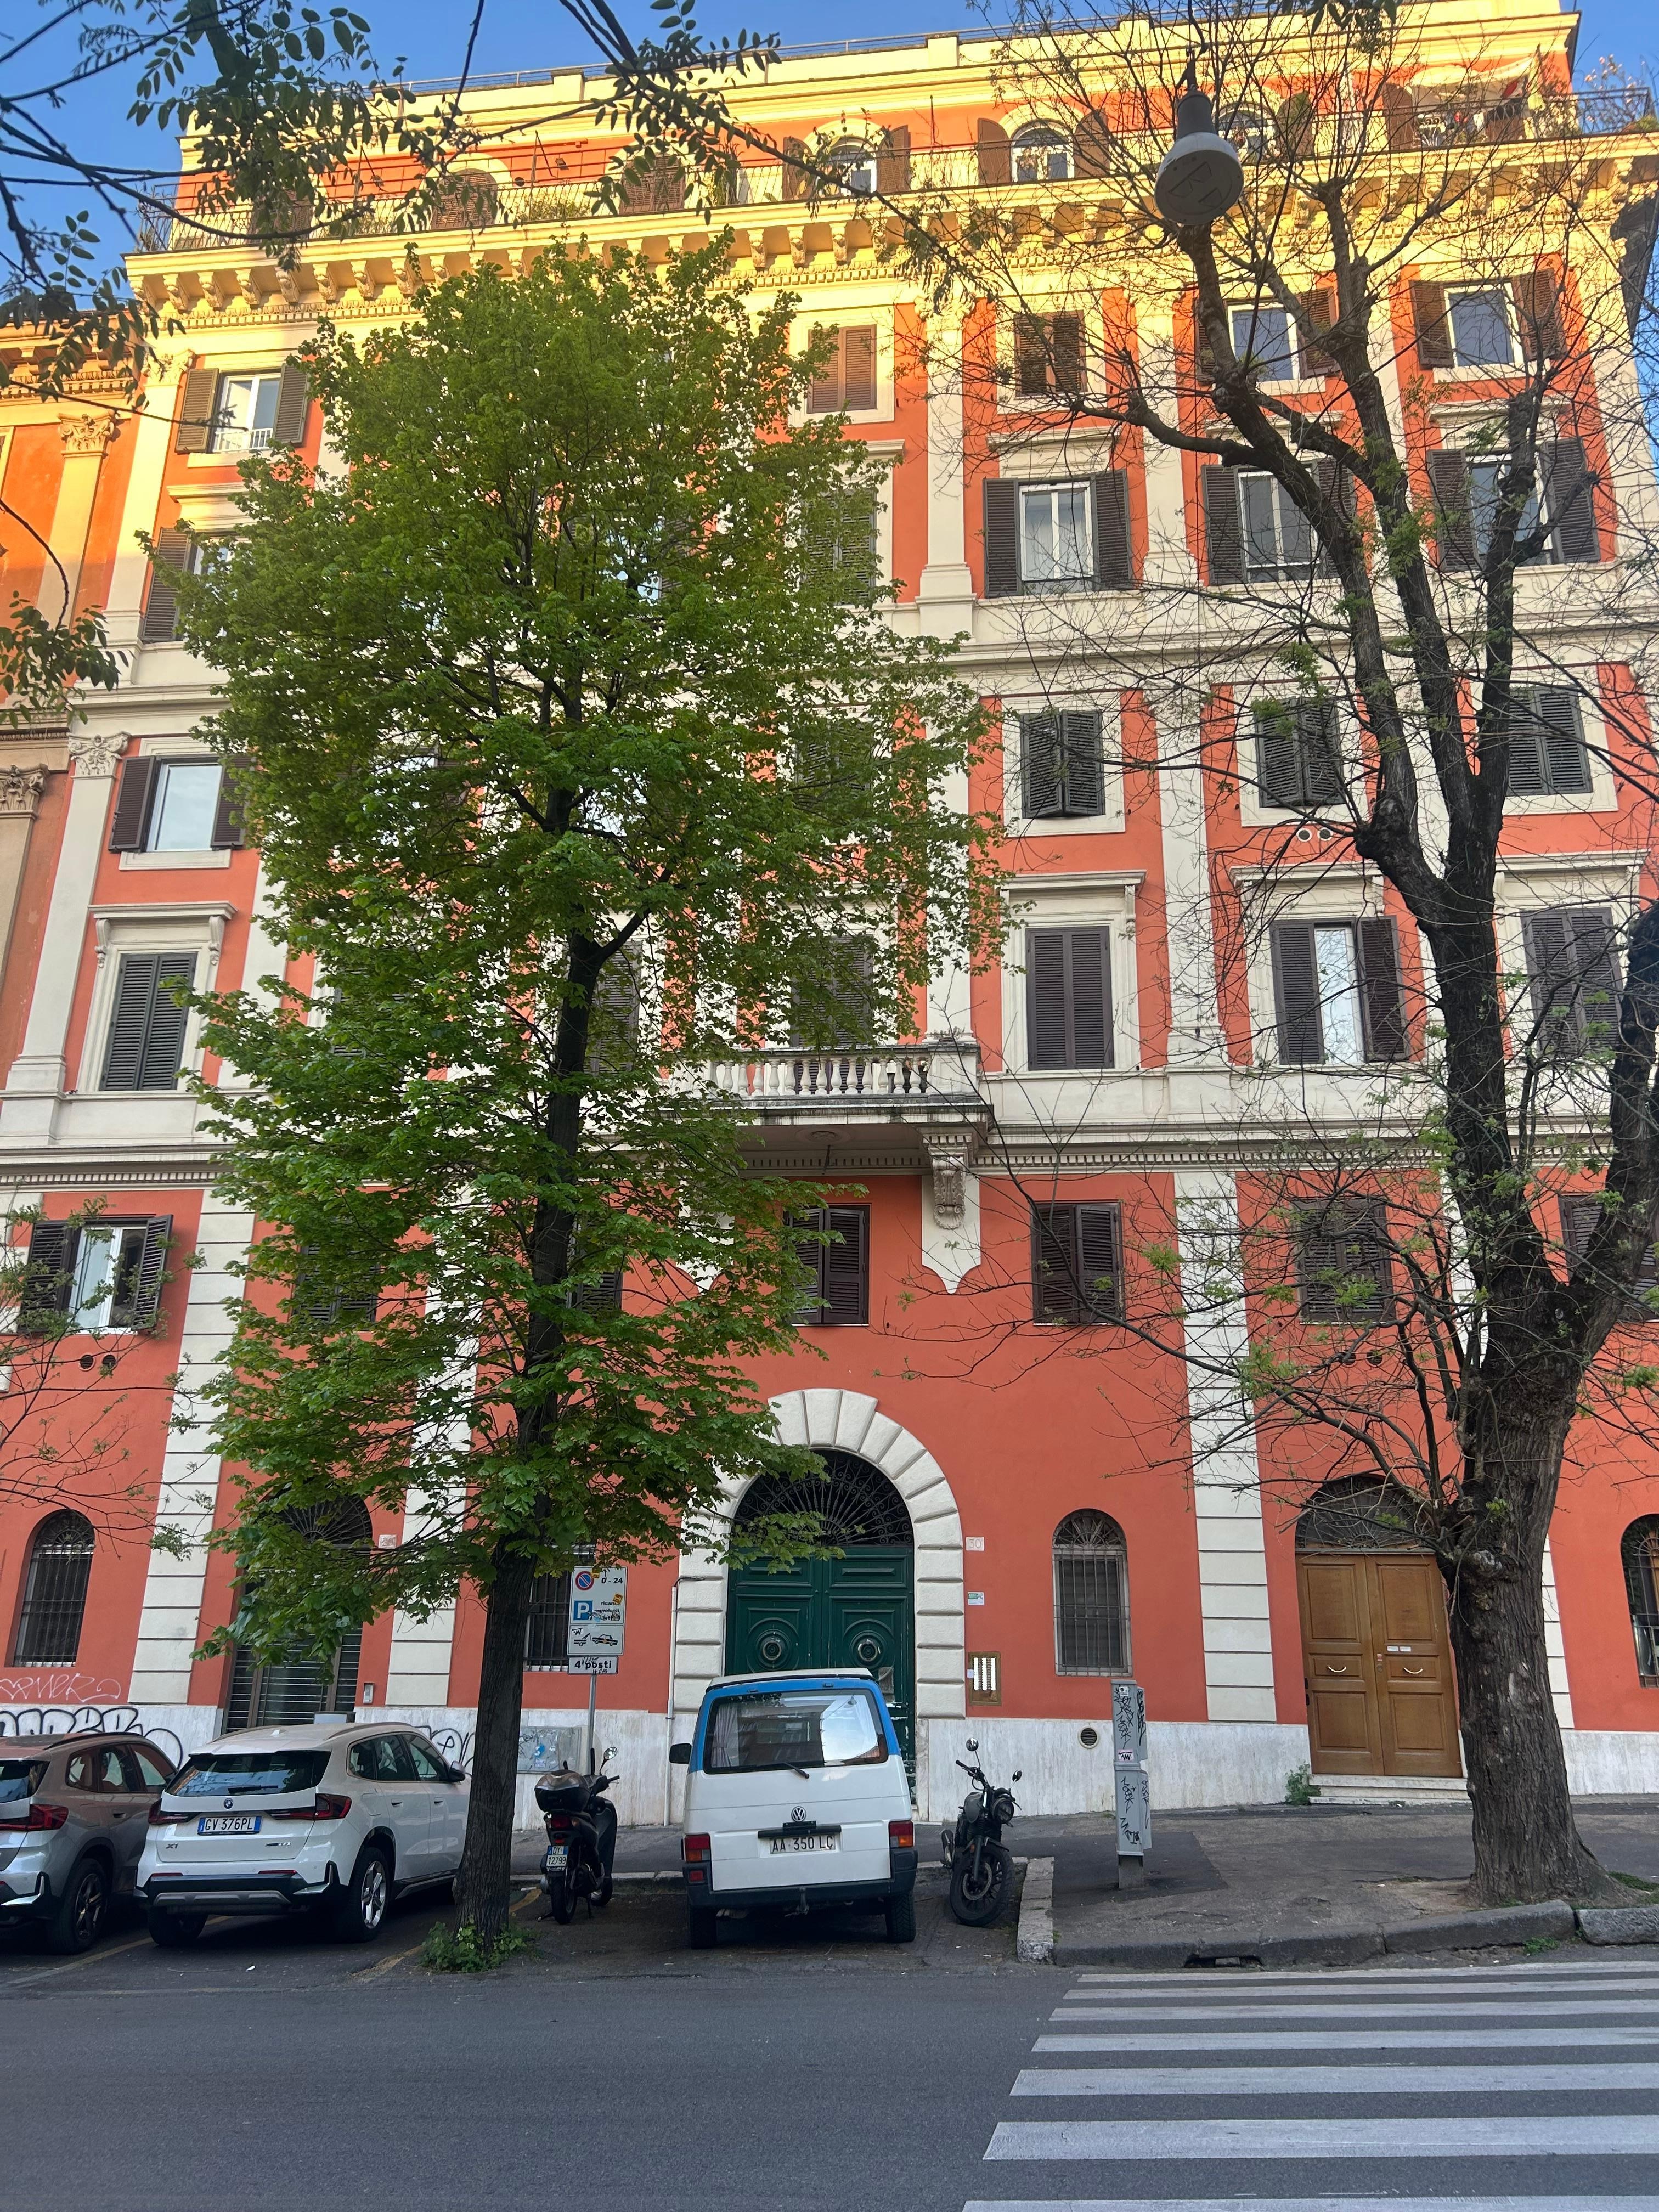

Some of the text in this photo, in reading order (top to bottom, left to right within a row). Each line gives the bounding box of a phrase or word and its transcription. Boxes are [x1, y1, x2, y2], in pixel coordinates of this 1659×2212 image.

[577, 1602, 590, 1619] P
[574, 1660, 581, 1668] 4
[585, 1660, 612, 1671] posti
[205, 1818, 253, 1831] GV 376PL
[772, 1839, 786, 1852] AA
[792, 1837, 814, 1850] 350
[549, 1856, 566, 1865] 12799
